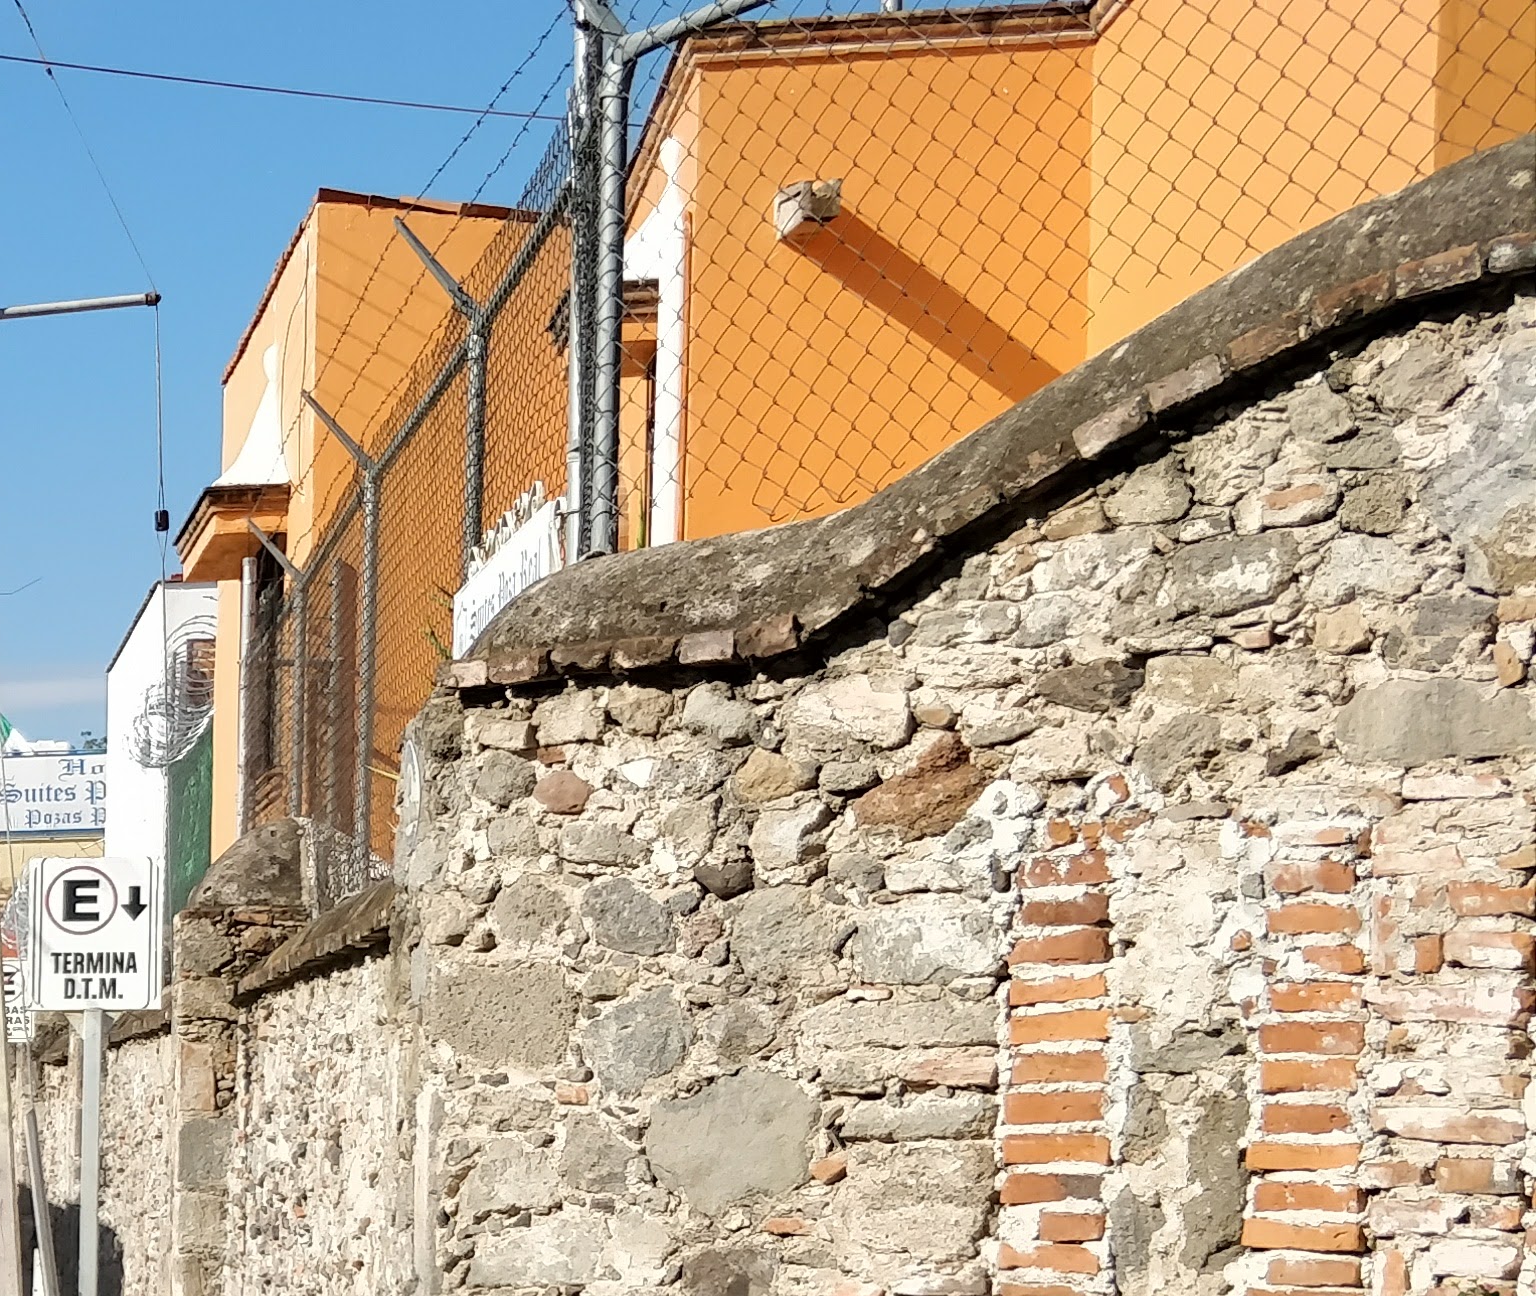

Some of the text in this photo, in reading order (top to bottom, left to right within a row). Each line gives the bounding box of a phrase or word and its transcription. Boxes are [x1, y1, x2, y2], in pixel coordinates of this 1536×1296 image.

[0, 782, 77, 804] Suites
[62, 879, 100, 922] E
[50, 952, 138, 974] TERMINA
[64, 978, 124, 1000] D.T.M.
